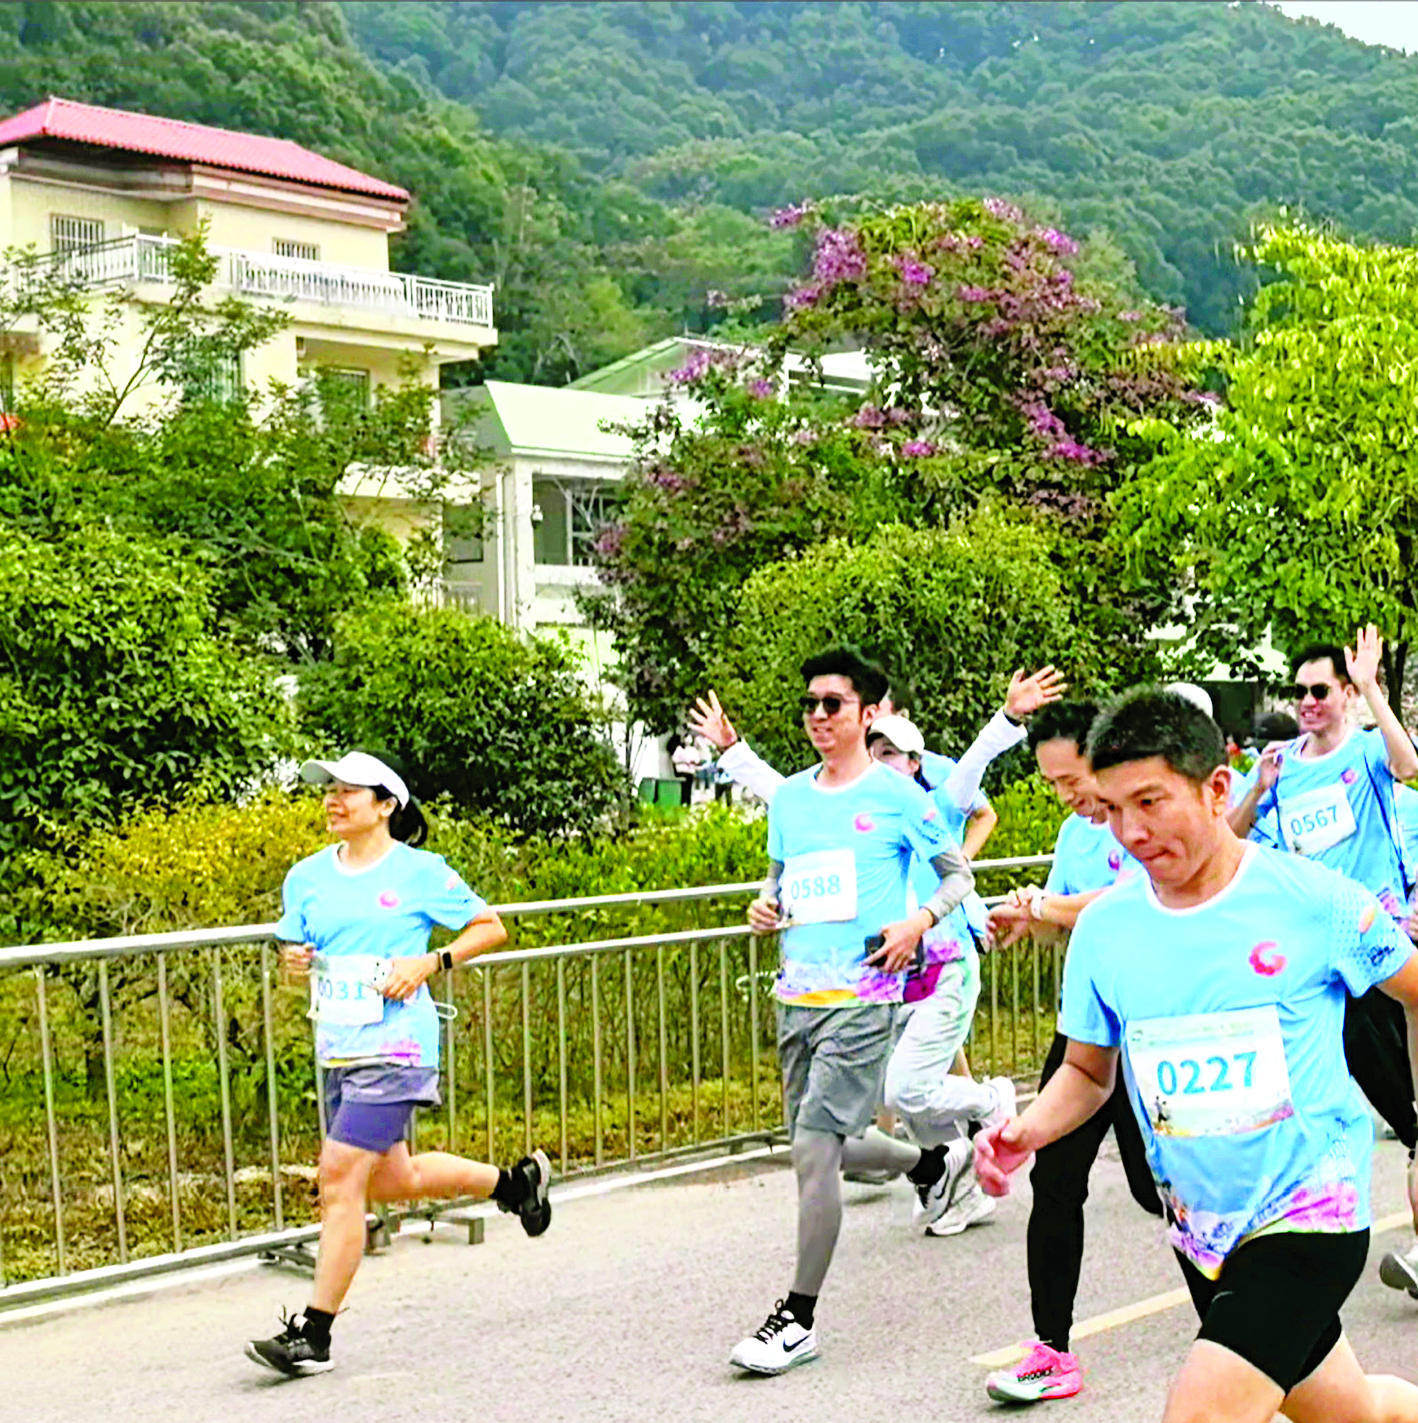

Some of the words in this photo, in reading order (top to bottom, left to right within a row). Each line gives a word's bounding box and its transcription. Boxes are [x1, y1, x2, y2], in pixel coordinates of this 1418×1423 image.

[1290, 804, 1338, 836] 0567
[790, 873, 842, 901] 0588
[1156, 1050, 1258, 1096] 0227
